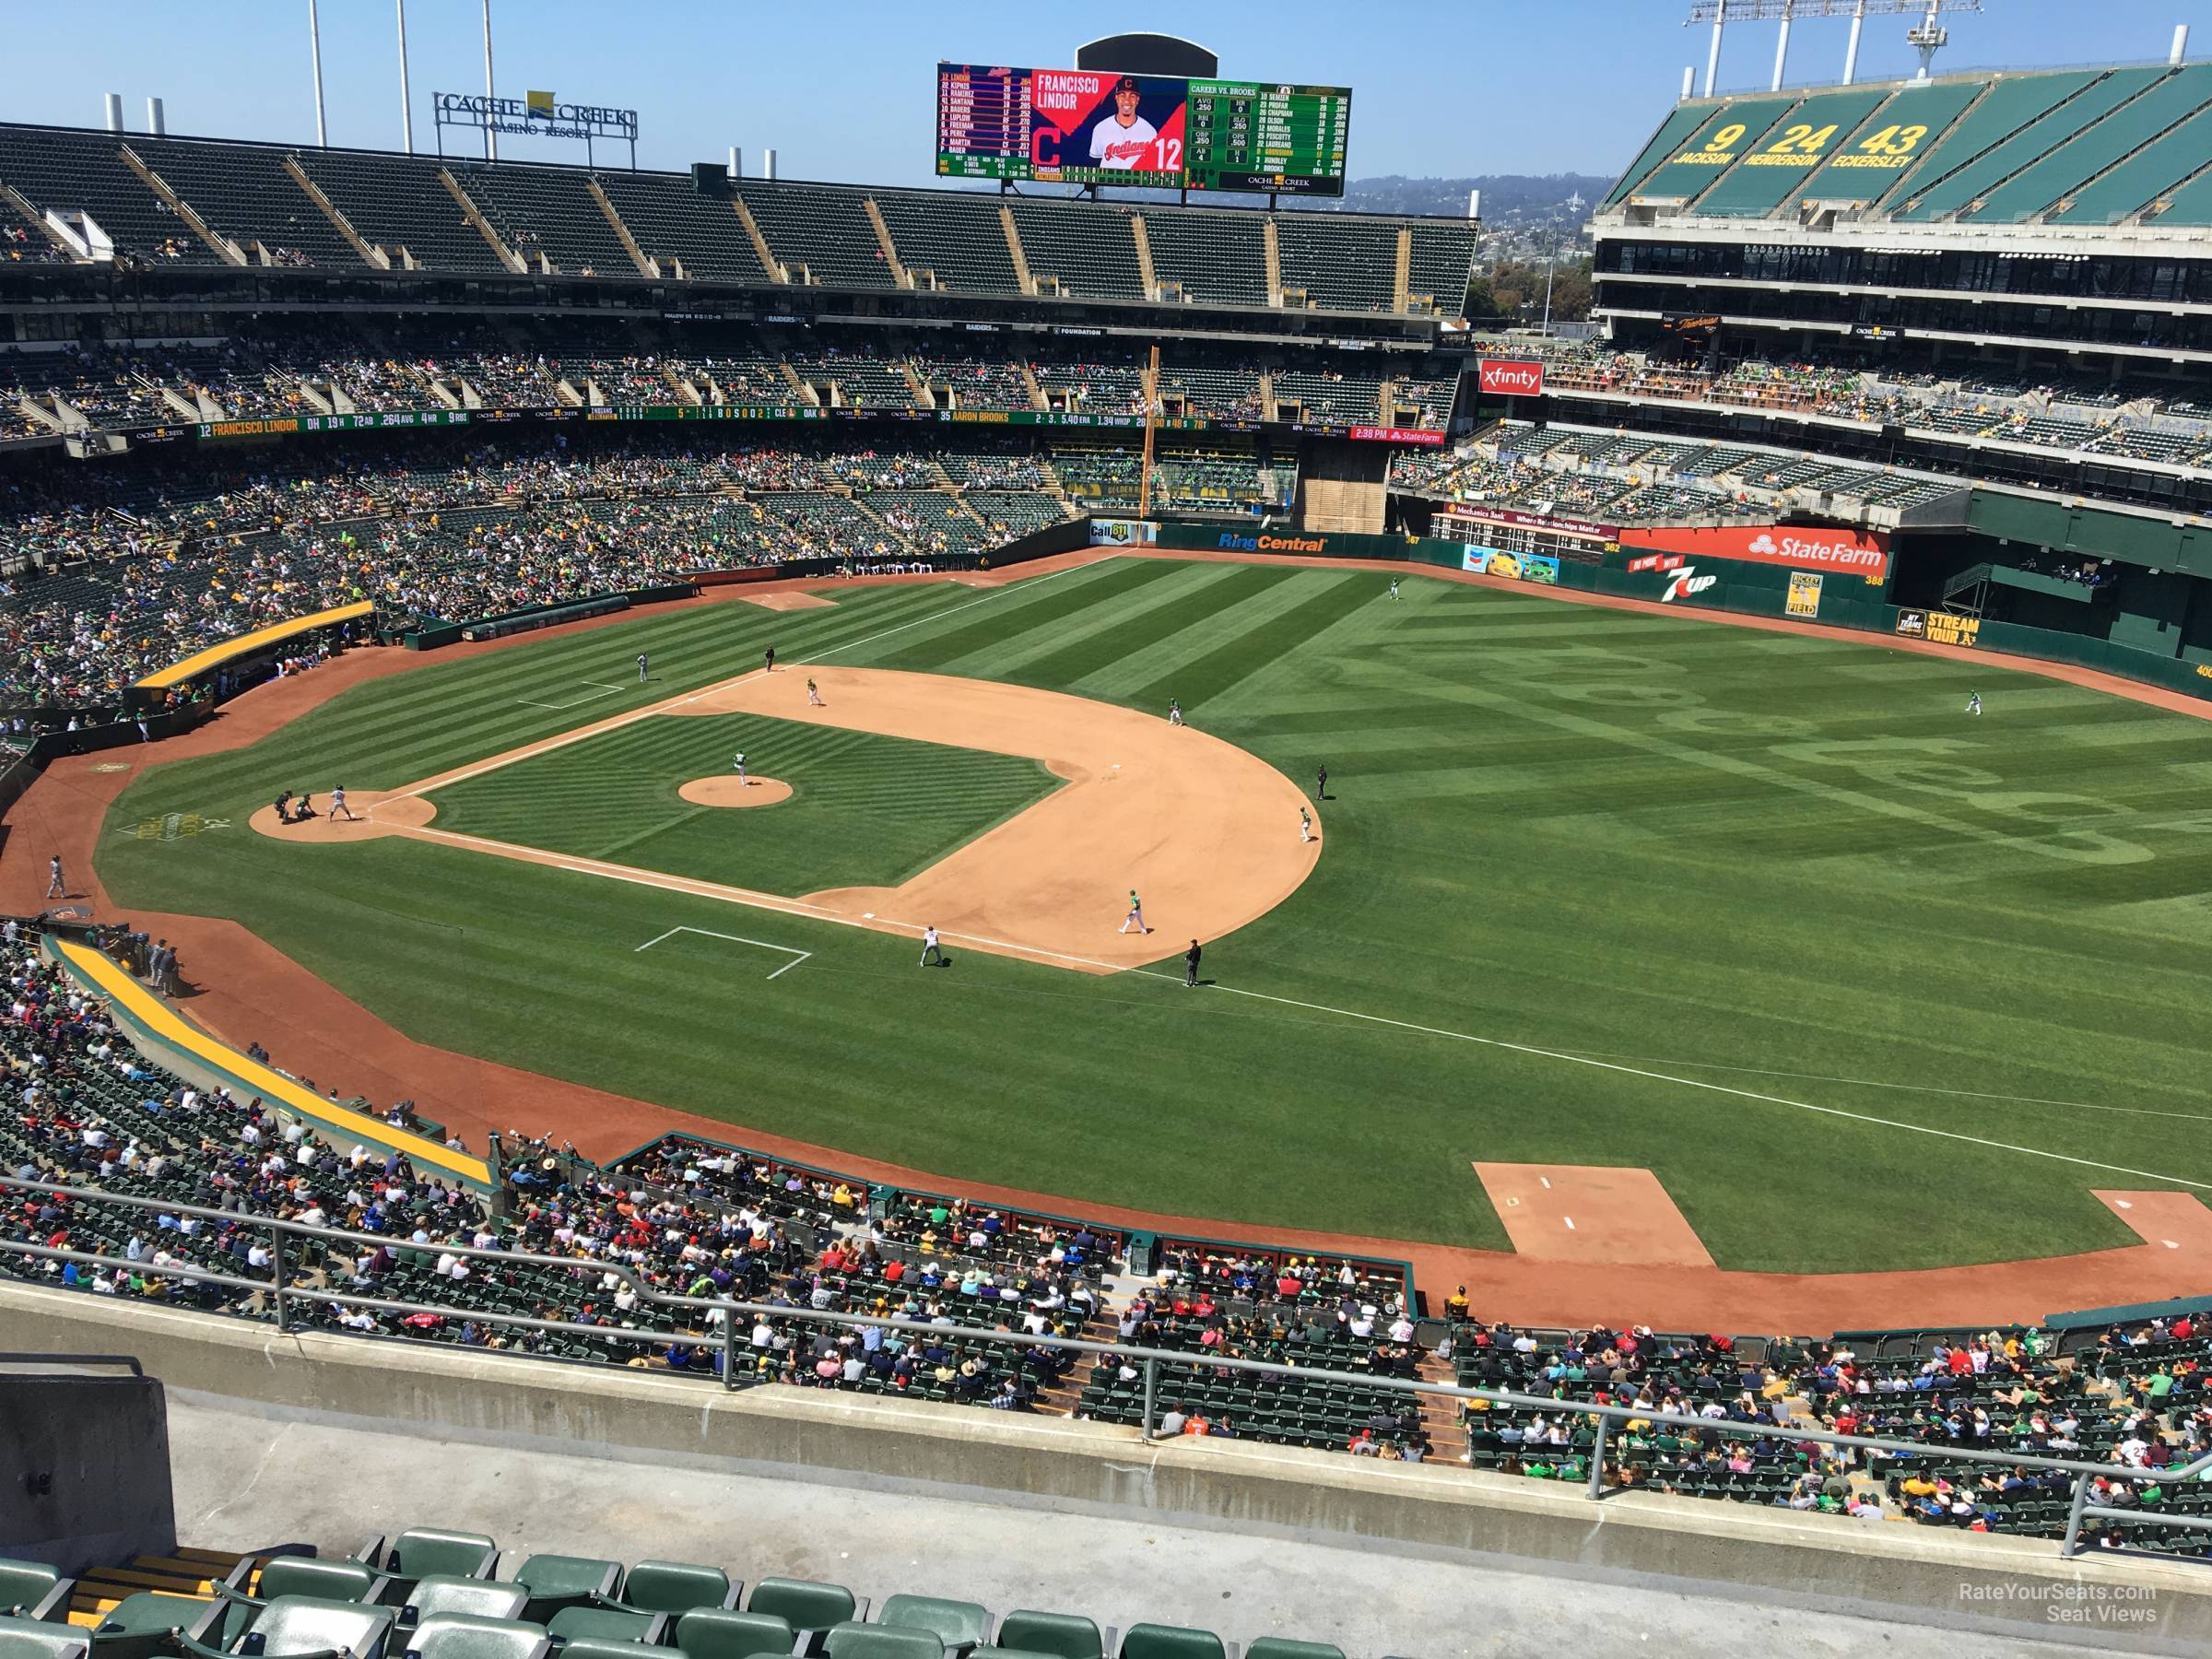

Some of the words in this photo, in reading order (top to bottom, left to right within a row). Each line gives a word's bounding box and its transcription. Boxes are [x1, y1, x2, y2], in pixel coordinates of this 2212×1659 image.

[1038, 74, 1100, 94] FRANCISCO
[1191, 85, 1217, 94] CAREER
[1230, 88, 1255, 96] BROOKS
[1037, 93, 1077, 111] LINDOR
[442, 93, 522, 116] CACHE
[559, 103, 635, 127] CREEK
[489, 121, 538, 135] CASINO
[546, 125, 592, 139] RESORT
[1705, 124, 1747, 152] 9
[1766, 124, 1839, 153] 24
[1859, 125, 1928, 155] 43
[1155, 137, 1182, 171] 12
[1674, 152, 1735, 165] JACKSON
[1745, 154, 1821, 167] HENDERSON
[1831, 155, 1913, 169] ECKERSLEY
[1248, 175, 1274, 184] CACHE
[1285, 178, 1310, 186] CREEK
[1484, 368, 1538, 389] xfinity
[677, 407, 684, 418] 5
[758, 408, 763, 418] 2
[774, 408, 786, 418] CLE
[803, 408, 818, 418] OAK
[940, 411, 951, 421] 35
[952, 412, 977, 421] AARON
[979, 412, 1009, 422] BROOKS
[1061, 415, 1078, 424] 5.40
[1097, 417, 1113, 426] 1.34
[200, 424, 211, 438] 12
[212, 420, 263, 437] FRANCISCO
[265, 418, 299, 433] LINDOR
[307, 418, 320, 430] DH
[1356, 428, 1373, 439] 2:38
[1374, 429, 1387, 440] PM
[1457, 505, 1489, 518] Mechanics
[1516, 515, 1536, 524] Where
[1579, 524, 1601, 535] Matter
[1090, 525, 1111, 537] Call
[1112, 524, 1127, 535] 811
[1218, 533, 1324, 552] RingCentral
[1604, 542, 1620, 553] 362
[1664, 558, 1680, 569] WITH
[1794, 574, 1819, 583] RICKEY
[1865, 575, 1884, 586] 388
[1788, 603, 1815, 614] FIELD
[1900, 618, 1923, 629] TEAMS
[1907, 613, 1920, 621] MY
[1928, 612, 1980, 633] STREAM
[1927, 626, 1959, 644] YOUR
[814, 1295, 826, 1305] 20
